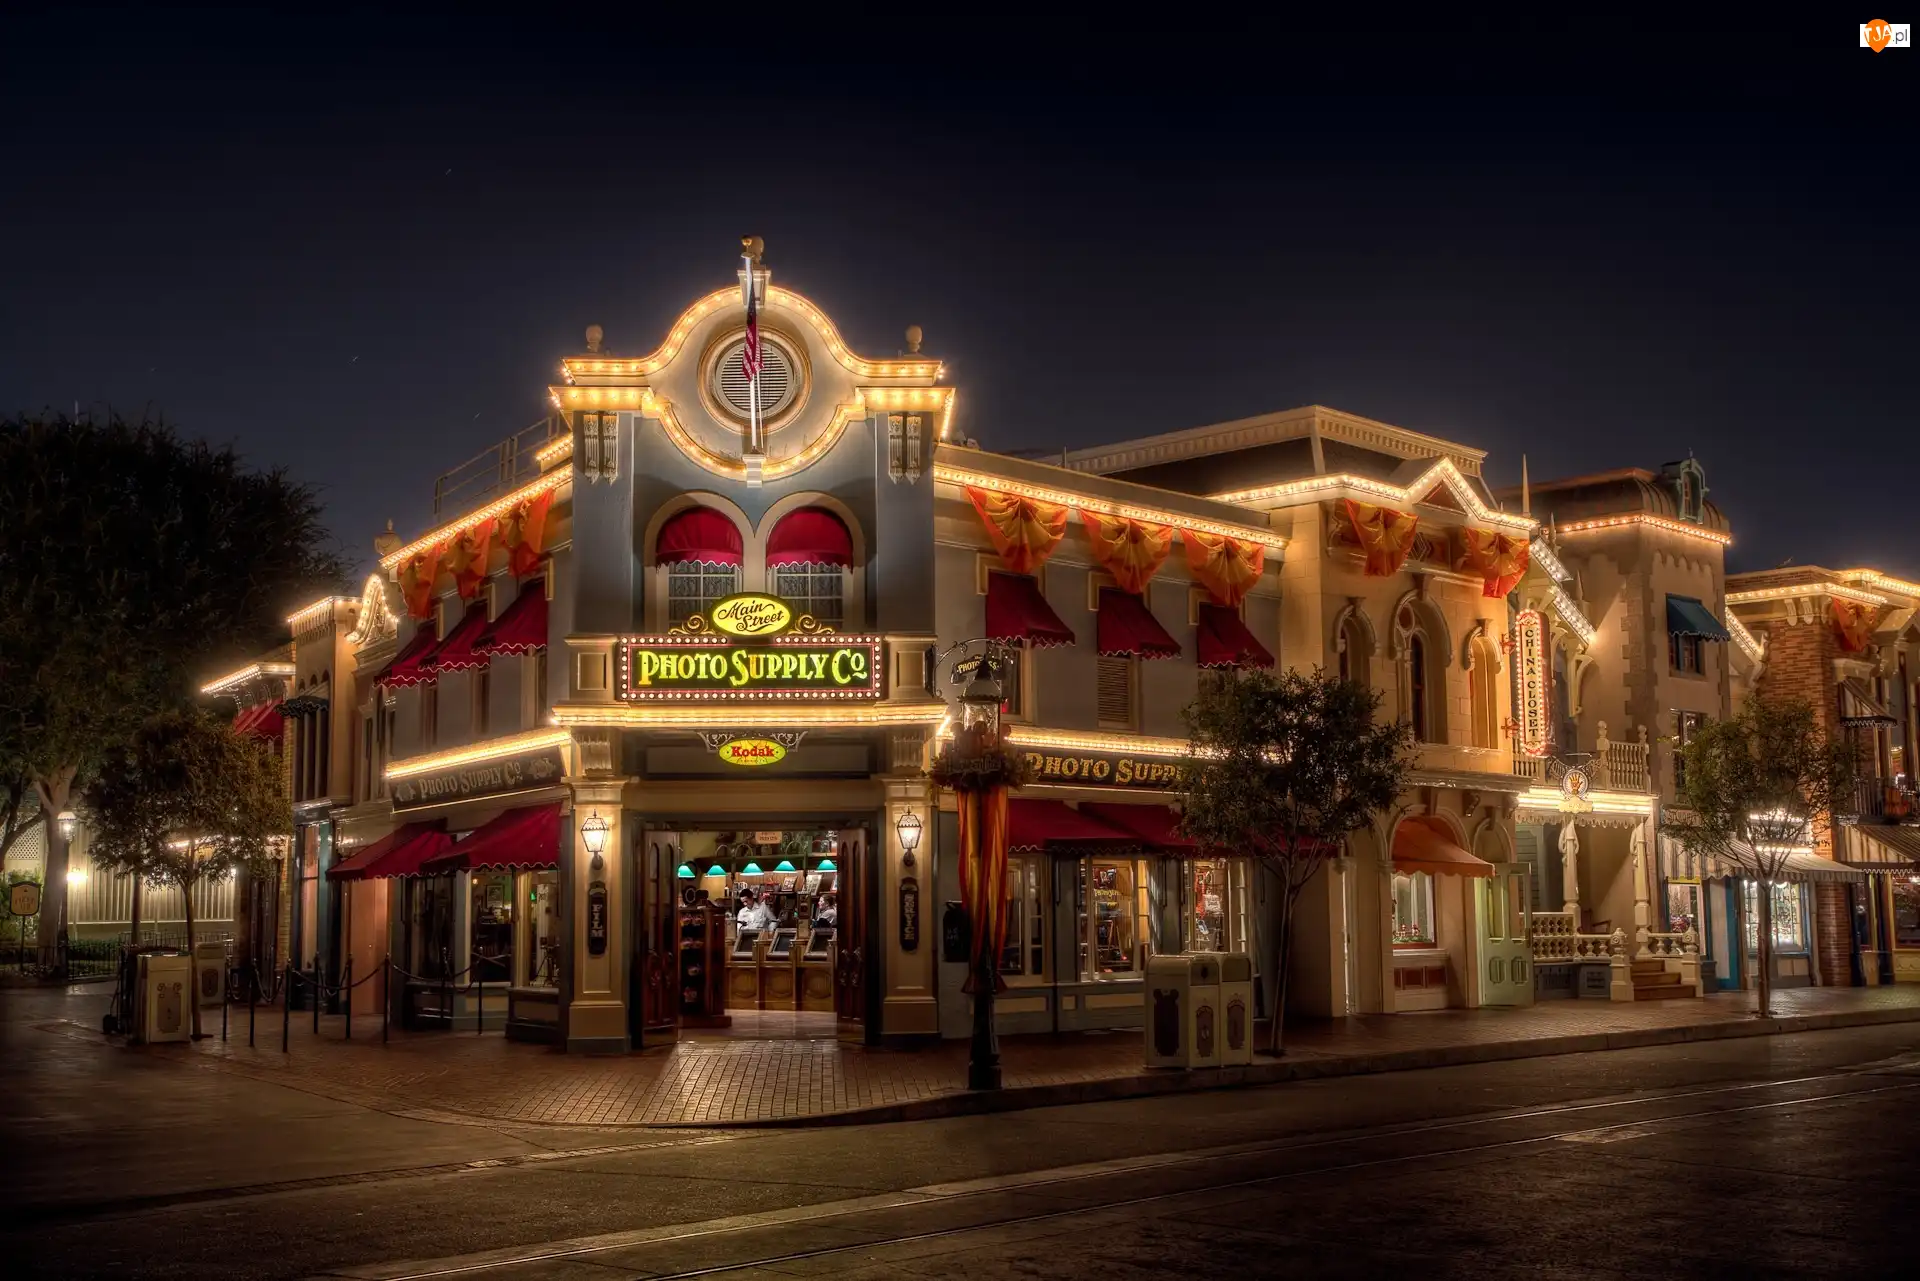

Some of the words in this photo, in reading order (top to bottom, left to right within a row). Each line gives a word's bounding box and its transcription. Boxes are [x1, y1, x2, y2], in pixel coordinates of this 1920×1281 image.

[717, 600, 776, 621] Main
[736, 610, 784, 633] Street
[1525, 629, 1536, 675] CHINA
[638, 650, 728, 686] PHOTO
[730, 649, 829, 687] SUPPLY
[1527, 681, 1539, 737] CLOSET
[731, 746, 775, 757] Kodak
[1025, 752, 1110, 779] PHOTO
[418, 777, 458, 798] PHOTO
[460, 767, 501, 793] SUPPLY
[590, 904, 605, 938] FILM
